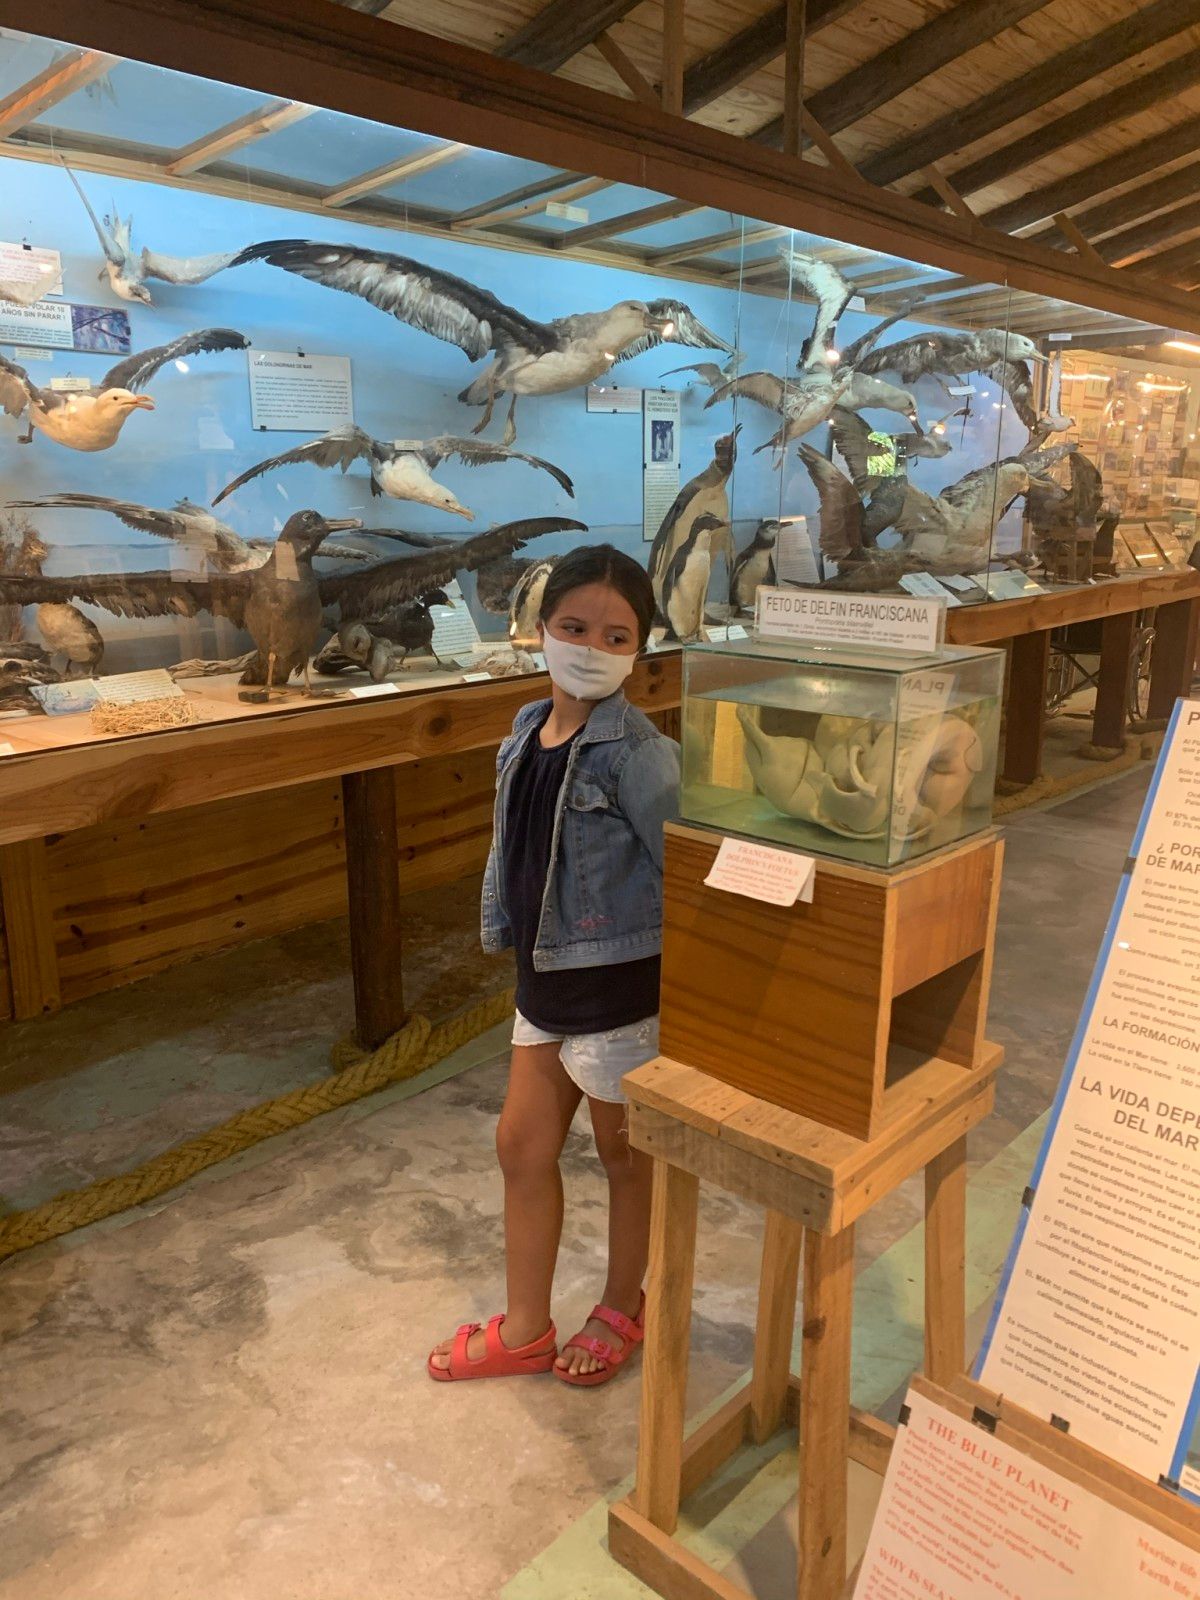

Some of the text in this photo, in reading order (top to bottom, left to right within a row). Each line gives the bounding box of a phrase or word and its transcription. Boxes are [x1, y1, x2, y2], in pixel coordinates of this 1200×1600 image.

[766, 596, 929, 623] FETO DE DELFIN FRANCISCANA
[1145, 854, 1167, 868] DE
[1102, 1015, 1200, 1052] LA FORMACIÓN
[1080, 1076, 1102, 1096] LA
[1110, 1085, 1149, 1112] VIDA
[1113, 1109, 1199, 1151] DEL MAR
[928, 1417, 1069, 1512] THE BLUE PLANET
[879, 1547, 905, 1573] WHY
[908, 1569, 920, 1583] IS
[921, 1578, 944, 1600] SEA
[1137, 1538, 1197, 1578] Marine life
[1139, 1560, 1190, 1597] Earth life
